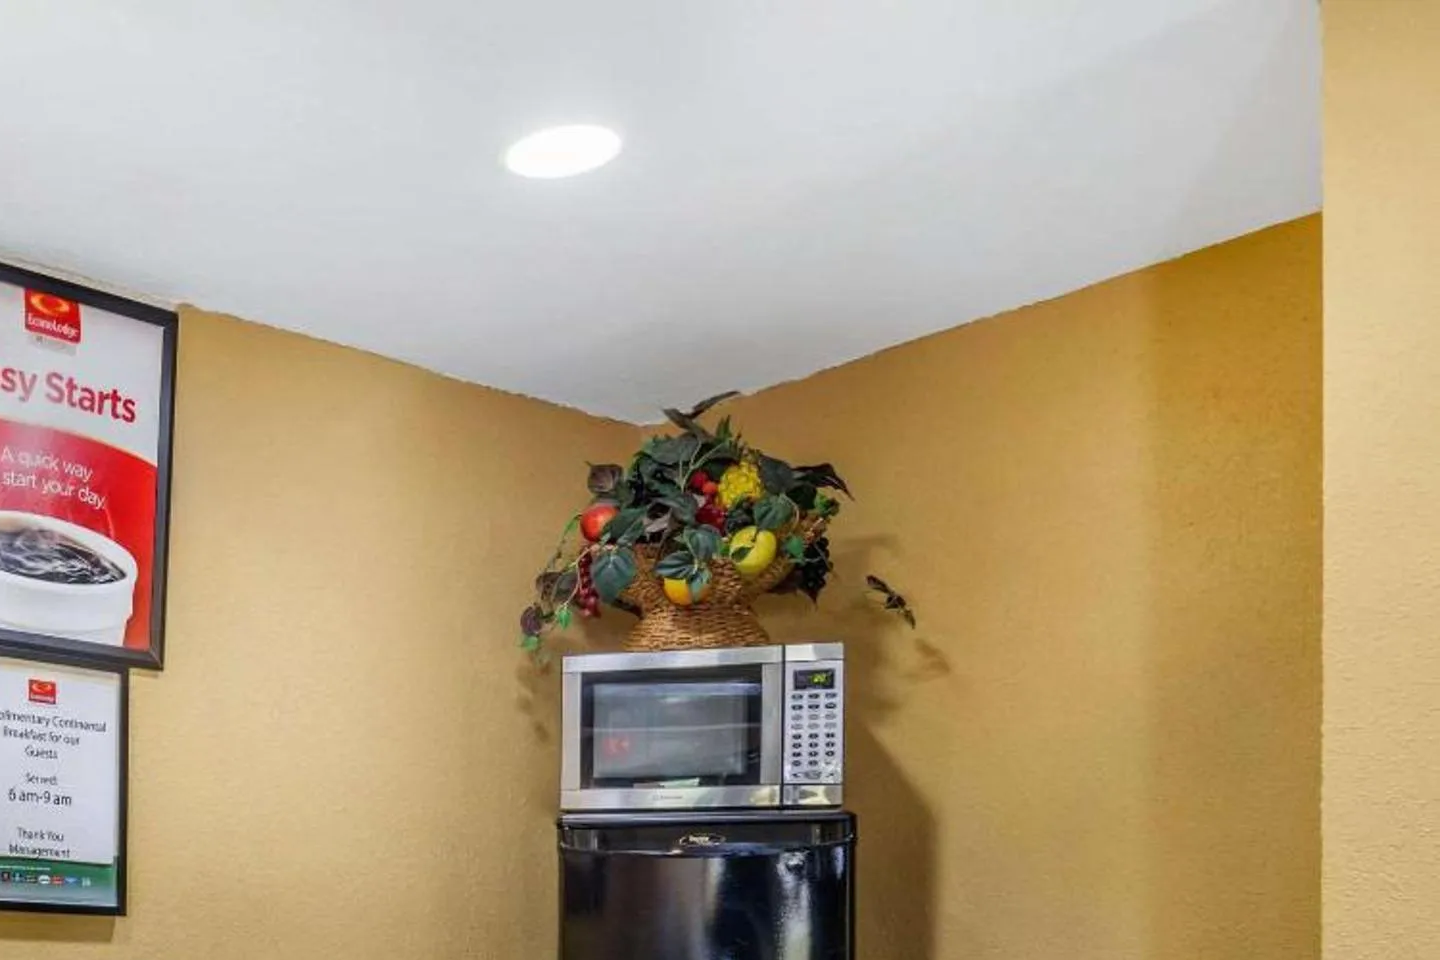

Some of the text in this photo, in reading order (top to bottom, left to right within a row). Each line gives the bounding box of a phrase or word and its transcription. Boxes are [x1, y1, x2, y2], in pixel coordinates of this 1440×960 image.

[45, 371, 136, 423] Starts
[0, 446, 93, 483] A quick way
[2, 470, 36, 488] start
[41, 478, 75, 496] your
[52, 716, 106, 732] Continental
[3, 725, 80, 745] Breakfast for our
[24, 744, 58, 760] Guests
[8, 787, 16, 802] 6
[53, 794, 72, 807] am
[16, 826, 64, 842] Thank You
[9, 843, 70, 858] Management
